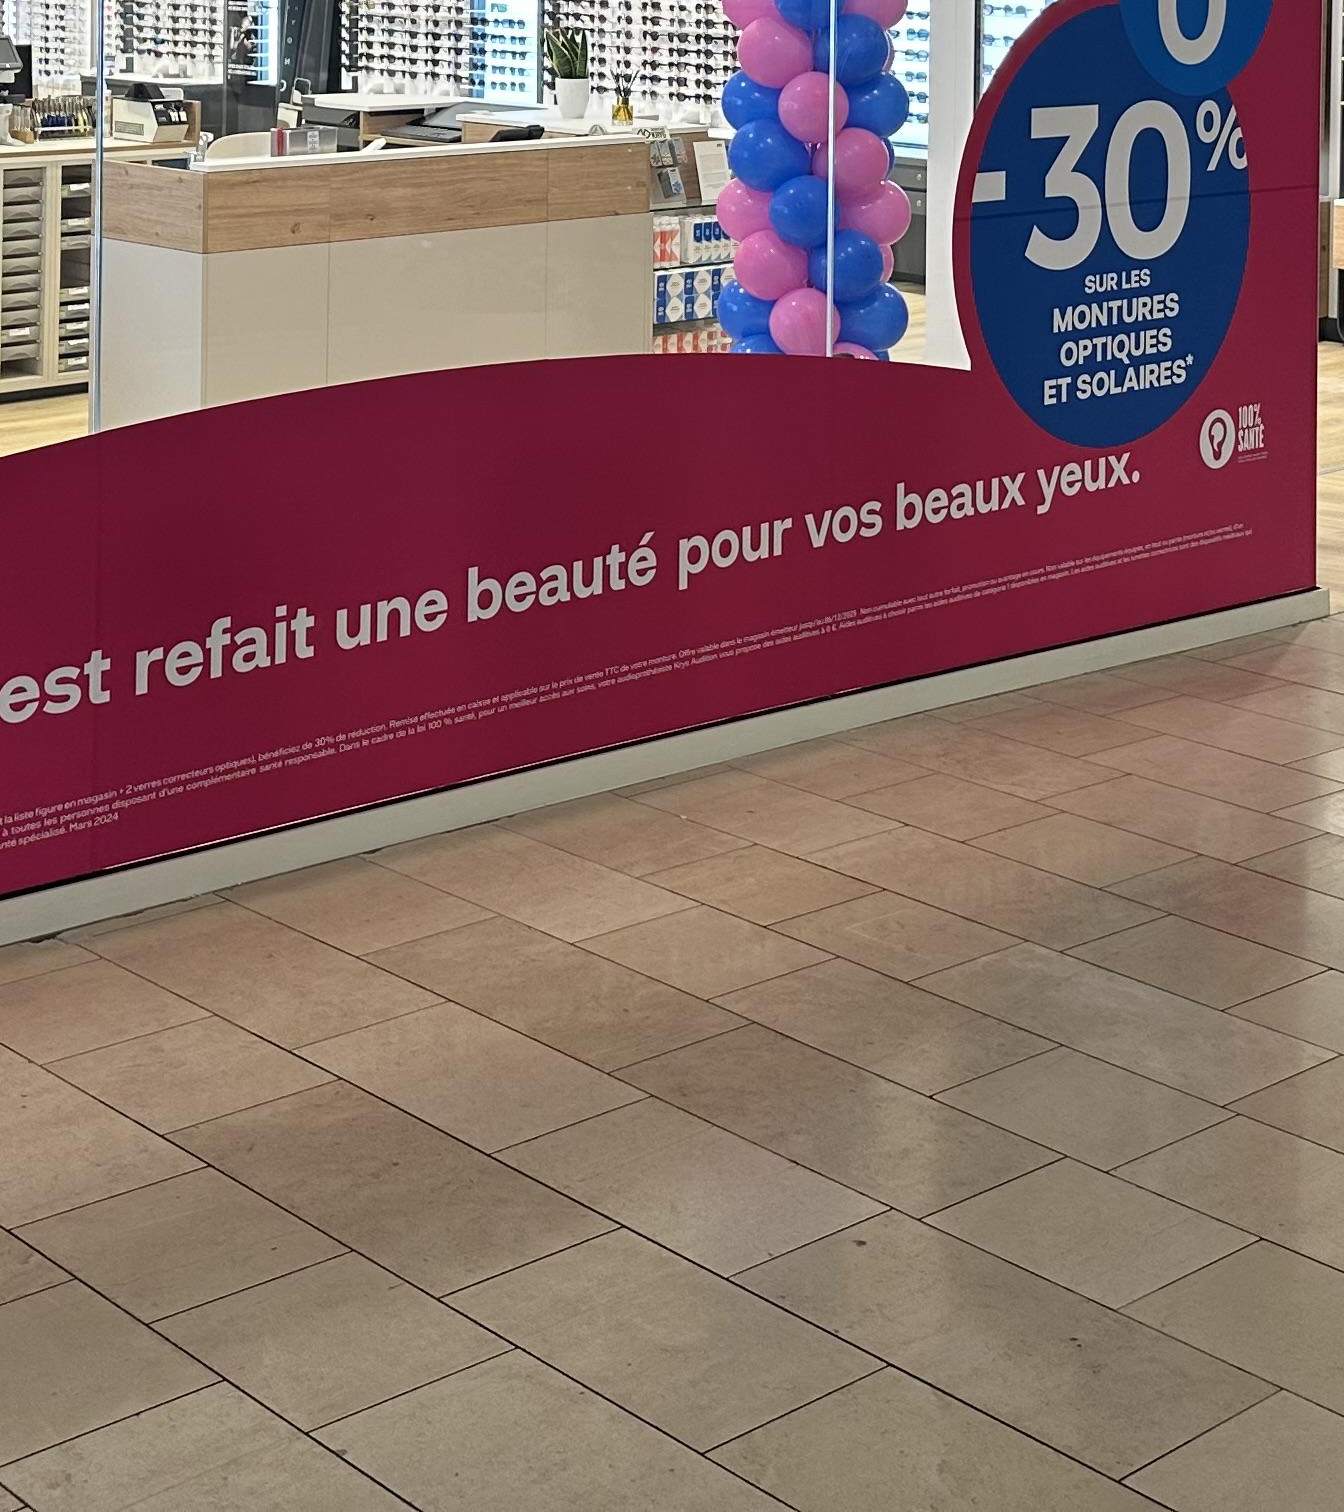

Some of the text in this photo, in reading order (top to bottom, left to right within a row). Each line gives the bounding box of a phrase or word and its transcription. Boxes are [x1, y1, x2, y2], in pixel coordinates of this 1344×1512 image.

[1084, 268, 1151, 294] SUR LES
[1053, 292, 1180, 333] MONTURES
[1060, 327, 1172, 367] OPTIQUES
[1043, 376, 1072, 406] ET
[1238, 402, 1262, 429] 100%
[1237, 423, 1265, 452] SANTÉ
[134, 605, 315, 696] refait
[335, 588, 449, 650] une
[466, 532, 657, 622] beauté
[677, 516, 793, 590] pour
[804, 504, 883, 548] vos
[895, 471, 1026, 531] beaux
[1034, 451, 1141, 515] yeux.
